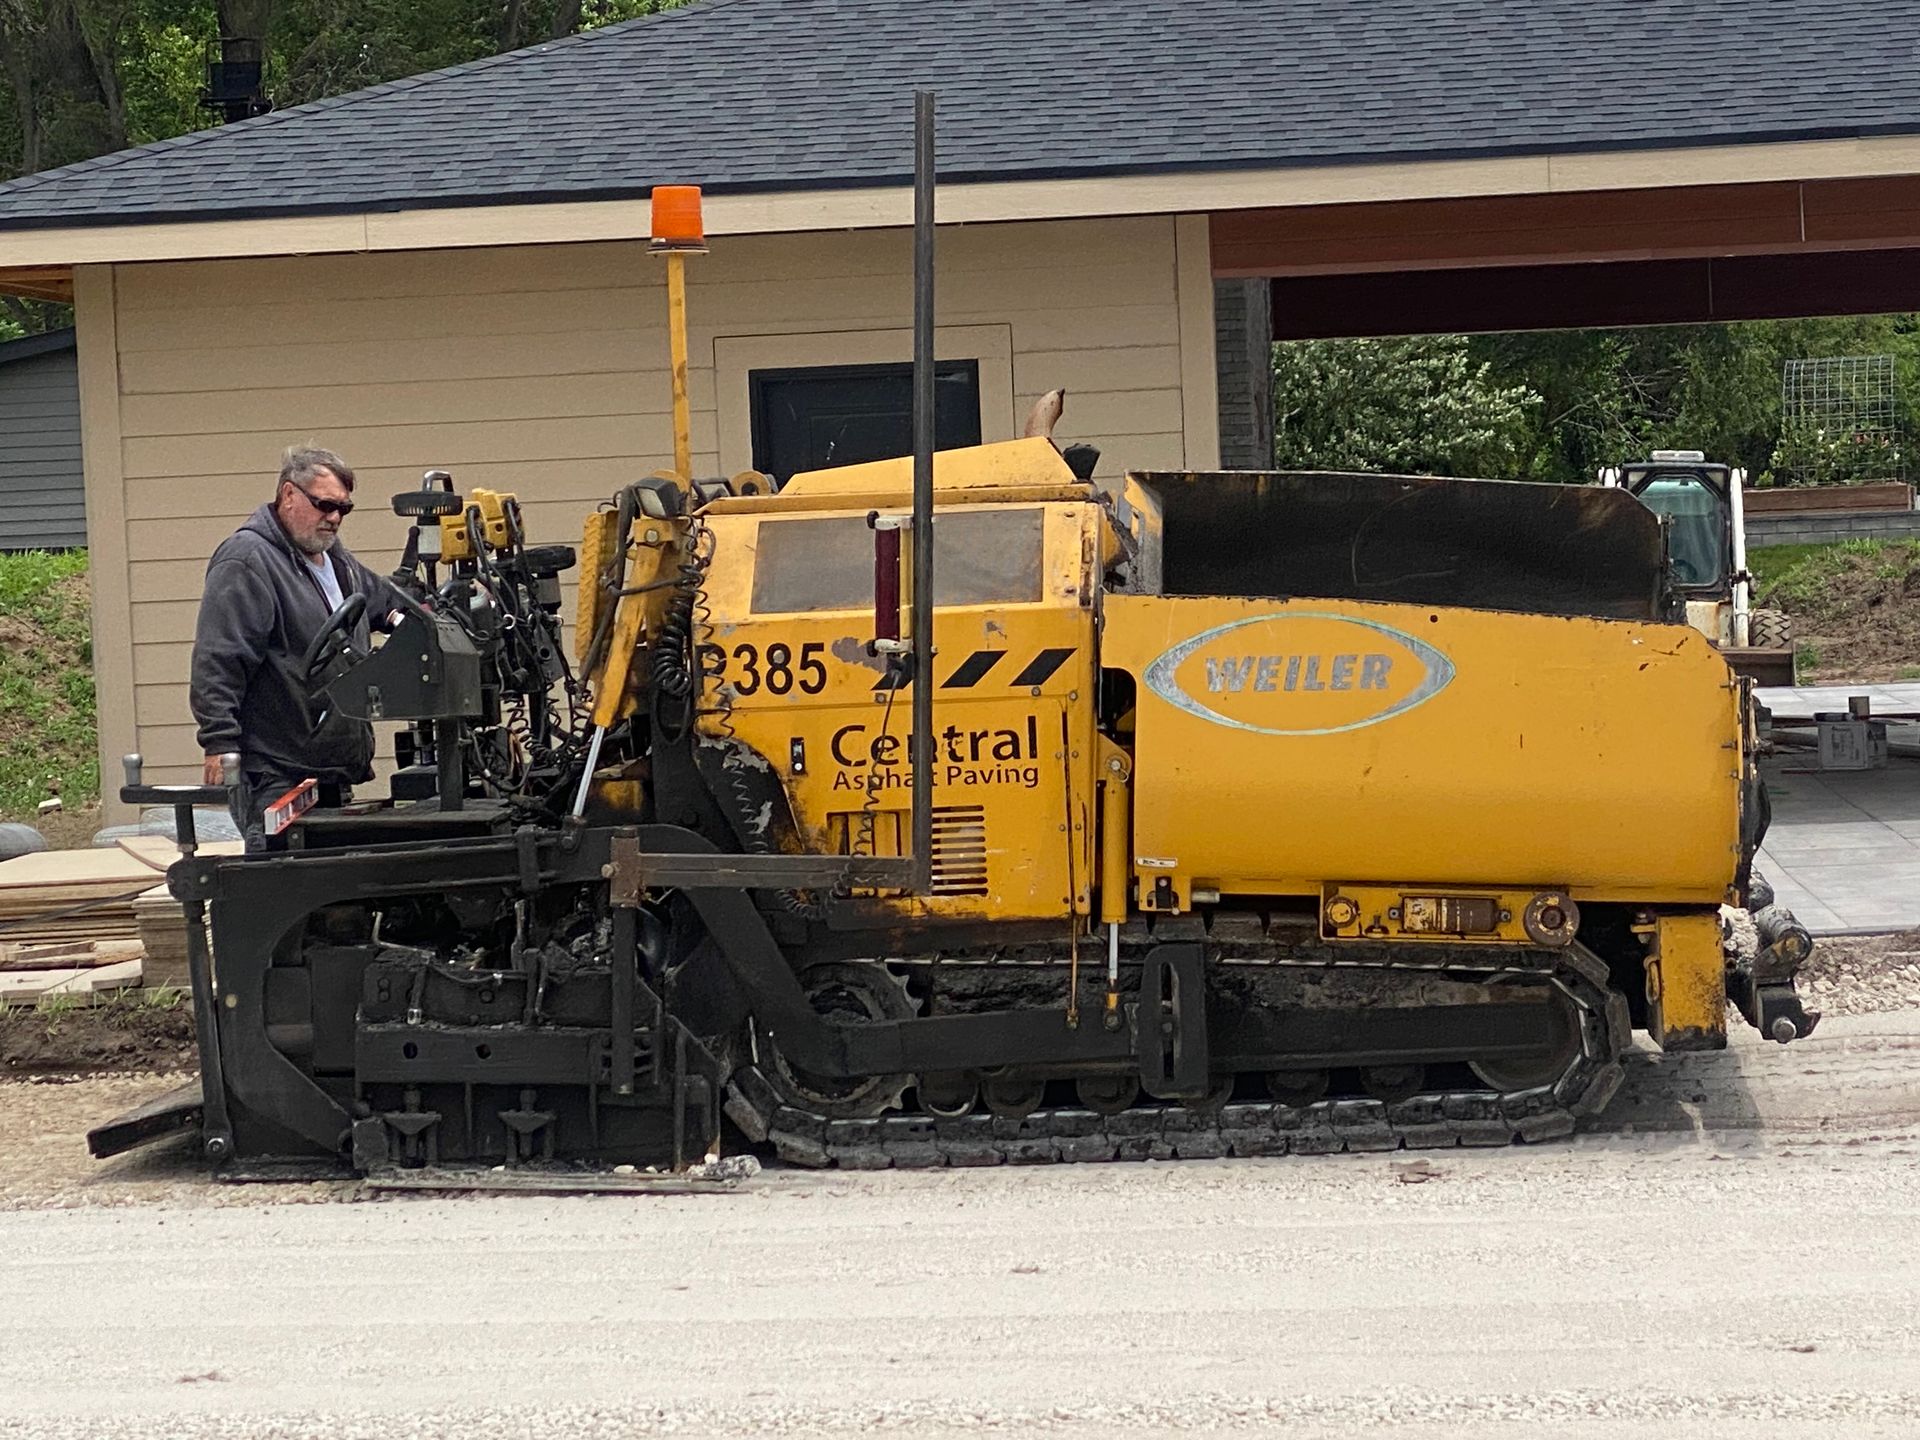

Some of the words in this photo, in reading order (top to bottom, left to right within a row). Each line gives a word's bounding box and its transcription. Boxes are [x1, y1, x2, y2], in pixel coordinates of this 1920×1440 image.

[1205, 653, 1393, 692] WEILER
[833, 768, 938, 793] Ashat
[946, 764, 1039, 789] Paving
